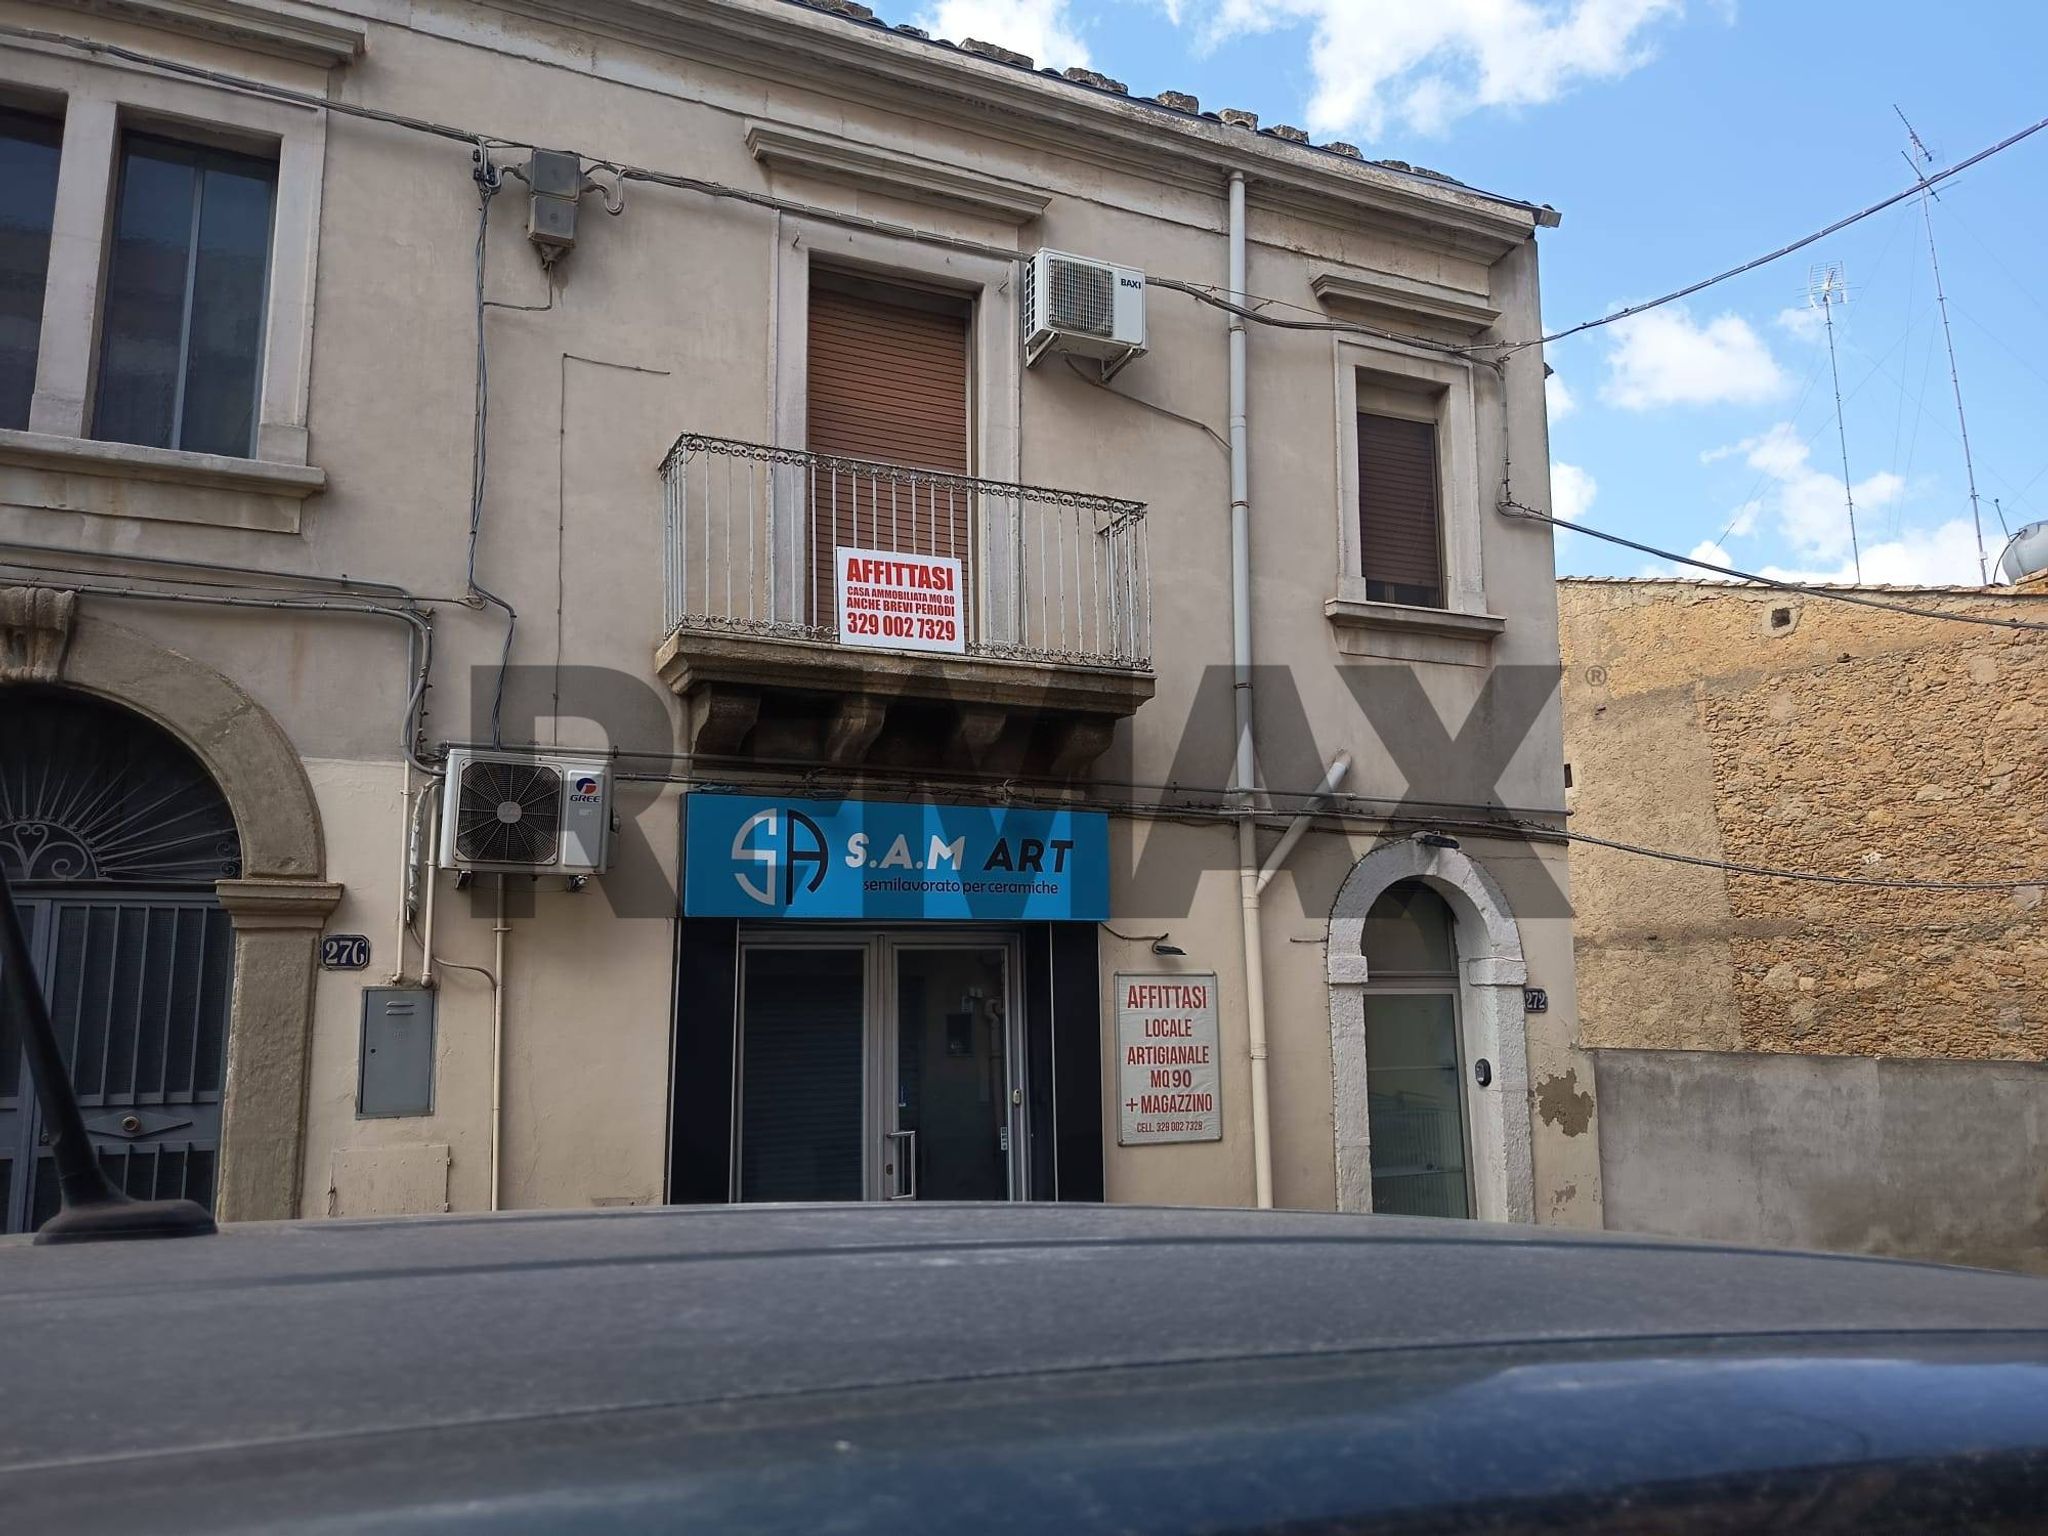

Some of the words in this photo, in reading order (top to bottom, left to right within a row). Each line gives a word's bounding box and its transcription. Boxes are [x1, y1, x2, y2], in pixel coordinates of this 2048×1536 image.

[1121, 278, 1142, 290] BAXI
[846, 558, 954, 591] AFFITTASI
[847, 586, 871, 597] CASA
[872, 589, 928, 602] AMMOBILIATA
[929, 594, 942, 605] MQ
[944, 595, 955, 605] 80
[847, 597, 881, 610] ANCHE
[883, 600, 913, 614] BREVI
[916, 604, 955, 618] PERIODI
[847, 612, 879, 635] 329
[883, 615, 914, 638] 002
[917, 618, 956, 641] 7329
[570, 795, 601, 803] GREE
[845, 833, 966, 871] S.A.M
[983, 838, 1075, 874] ART
[863, 877, 960, 894] semilavorato
[962, 883, 985, 895] per
[988, 880, 1059, 895] ceramiche
[325, 940, 365, 965] 276
[1127, 985, 1207, 1009] AFFITTASI
[1525, 991, 1546, 1009] 272
[1145, 1019, 1193, 1038] LOCALE
[1127, 1046, 1210, 1065] ARTIGIANALE
[1150, 1070, 1170, 1089] MQ
[1172, 1070, 1192, 1088] 90
[1141, 1093, 1213, 1114] MAGAZZINO
